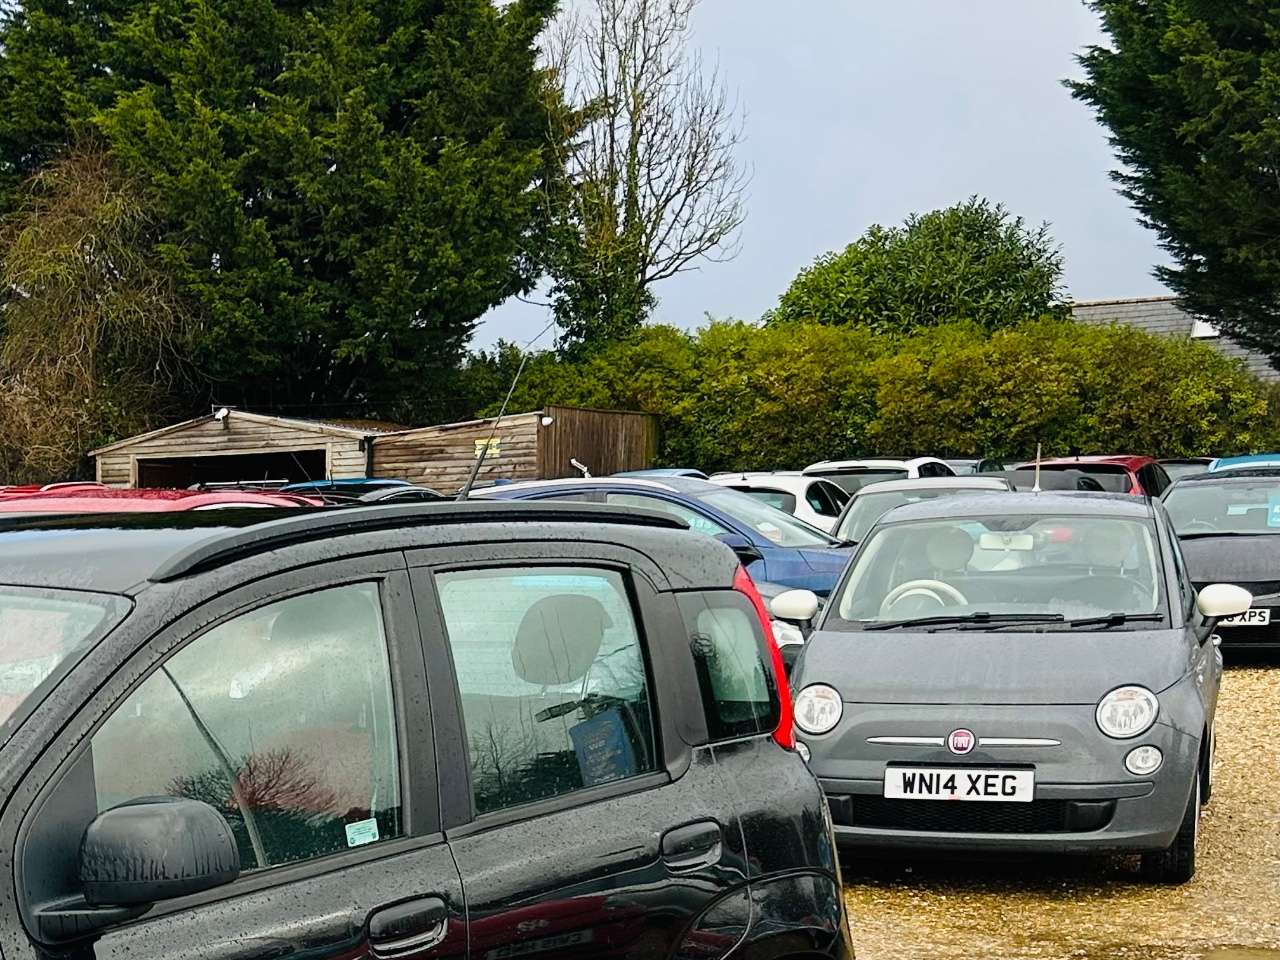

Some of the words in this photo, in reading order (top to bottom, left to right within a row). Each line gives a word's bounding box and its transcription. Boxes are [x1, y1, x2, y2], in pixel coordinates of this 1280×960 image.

[1239, 611, 1266, 623] XPS
[902, 772, 958, 795] WN14
[966, 774, 1017, 796] XEG
